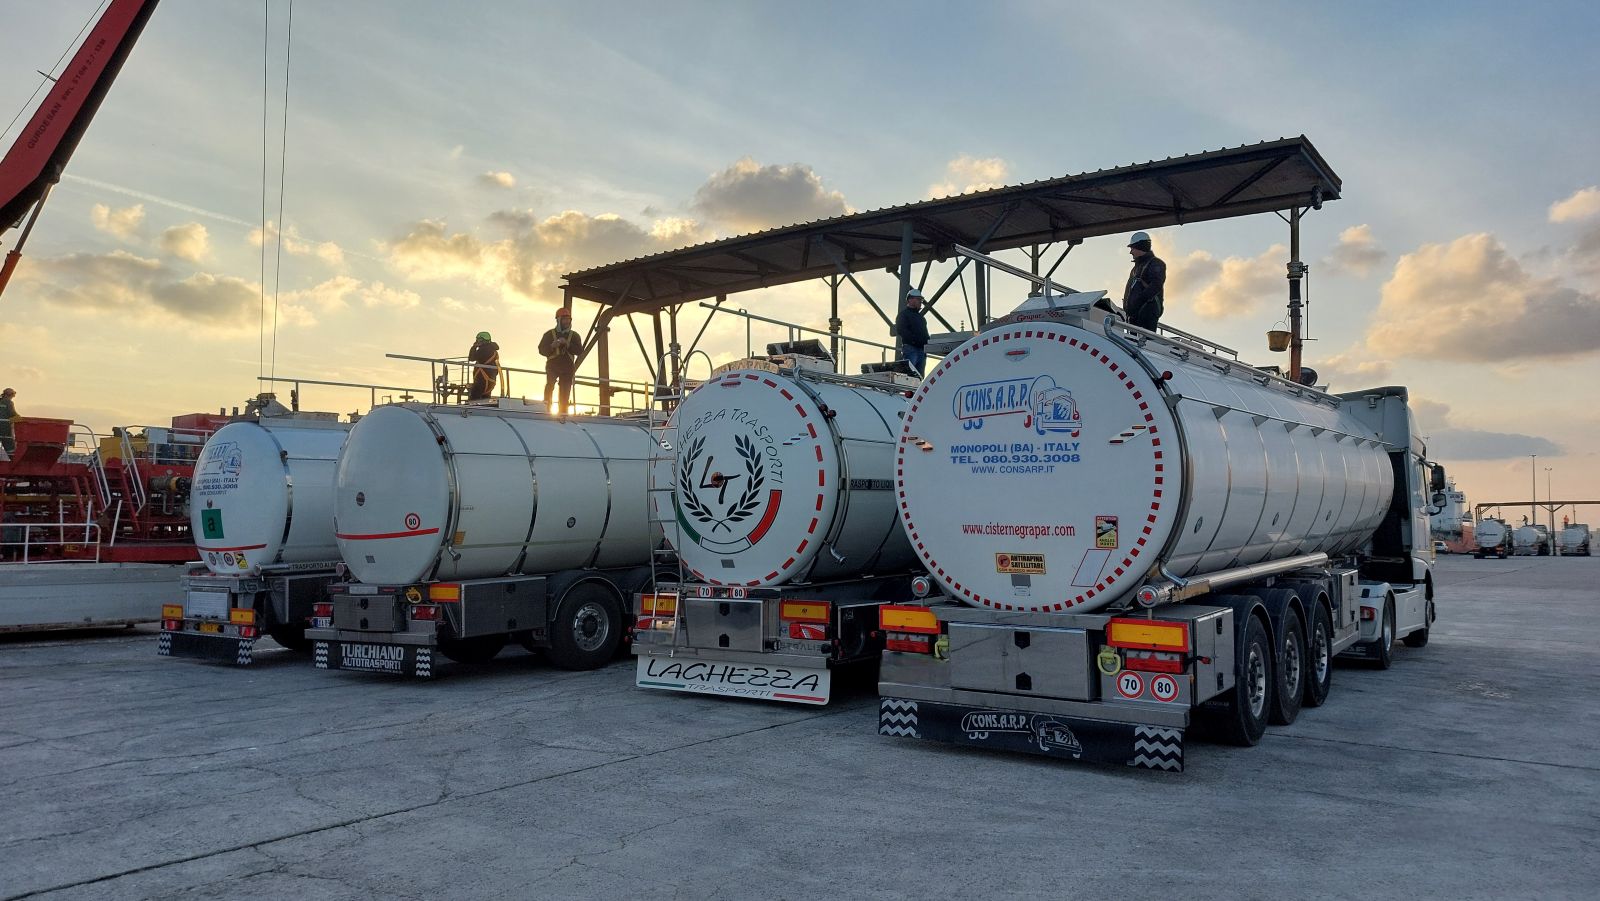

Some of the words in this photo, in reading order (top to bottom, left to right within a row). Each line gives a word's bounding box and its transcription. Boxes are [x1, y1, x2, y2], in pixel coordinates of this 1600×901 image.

[731, 407, 784, 485] TRASPORTI
[950, 444, 1007, 454] MONOPOLI
[1010, 443, 1034, 454] (BA)
[1044, 442, 1080, 452] ITALY
[950, 455, 979, 464] TEL.
[982, 453, 1081, 464] 080.930.3008
[1000, 465, 1055, 474] CONSARP.IT
[207, 517, 215, 532] a
[962, 522, 1076, 539] www.cisternegrapar.com
[1010, 555, 1044, 563] ANTIRAPINA
[701, 588, 710, 596] 70
[734, 588, 743, 597] 80
[340, 643, 405, 661] TURCHIANO
[342, 656, 402, 670] AUTOTRASPORTI
[646, 658, 819, 692] LAGHEZZA
[687, 683, 771, 697] TRASPORTI
[1124, 678, 1138, 691] 70
[1157, 681, 1171, 694] 80
[971, 714, 1029, 730] CONS.A.R.P.
